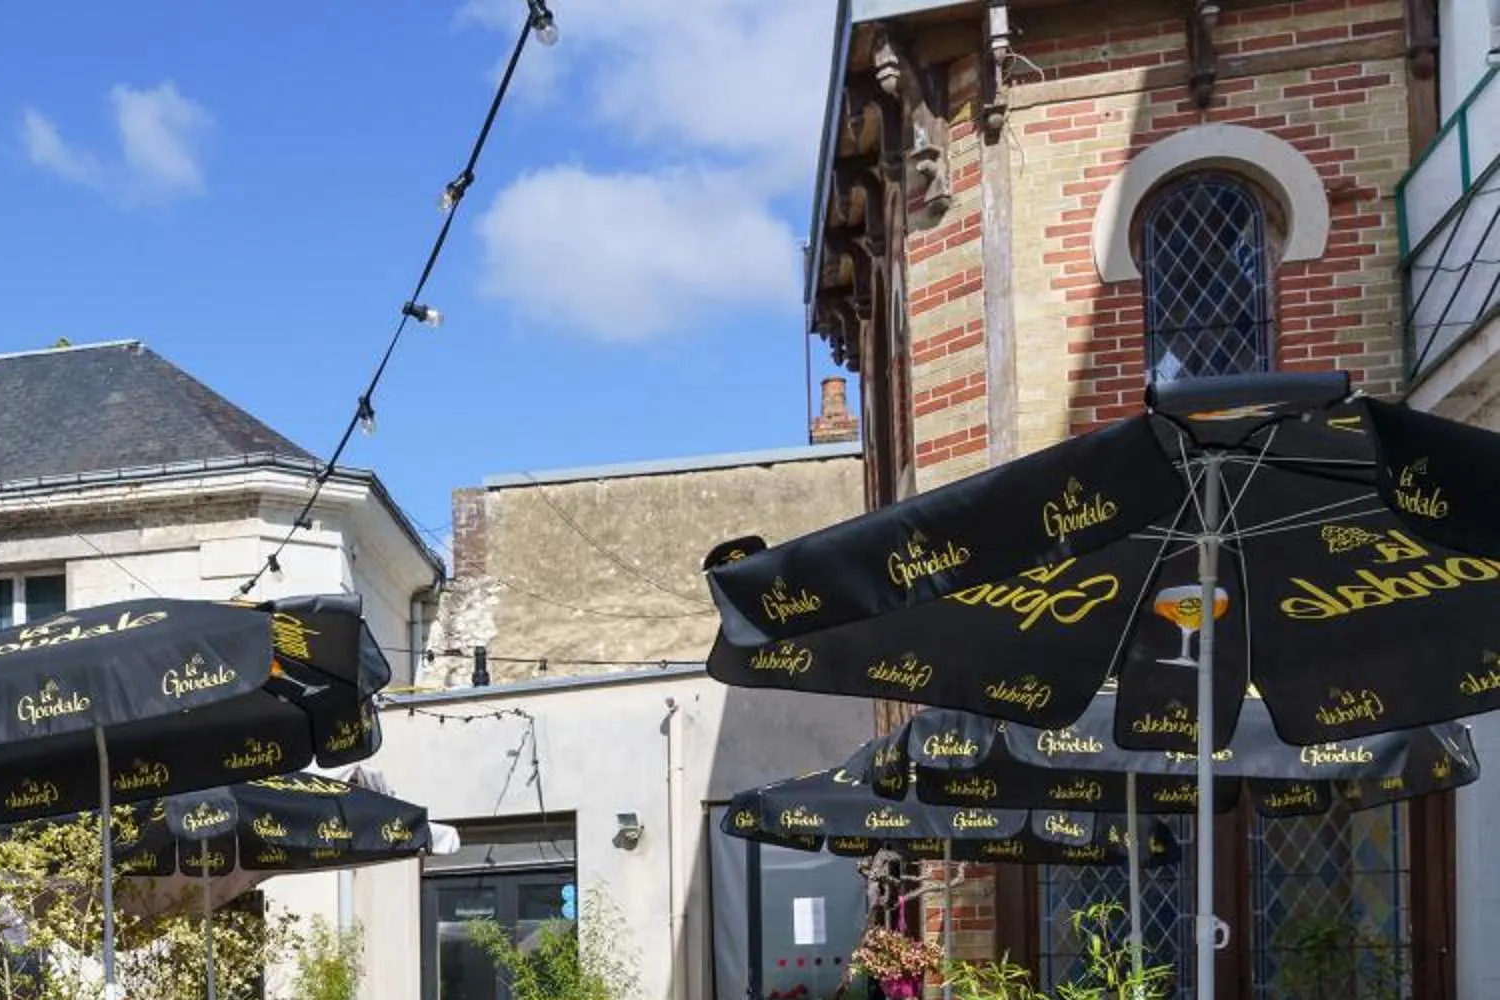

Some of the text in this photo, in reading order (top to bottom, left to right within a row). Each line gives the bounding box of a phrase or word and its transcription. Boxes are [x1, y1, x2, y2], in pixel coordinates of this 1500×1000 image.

[1043, 493, 1118, 543] Goudale
[888, 541, 971, 588] Goudale
[761, 588, 822, 624] Goudale
[161, 665, 236, 698] Goudale
[17, 691, 90, 725] Goudale
[923, 735, 979, 759] Goudale
[1036, 729, 1104, 756] Goudale
[1300, 745, 1374, 767] Goudale
